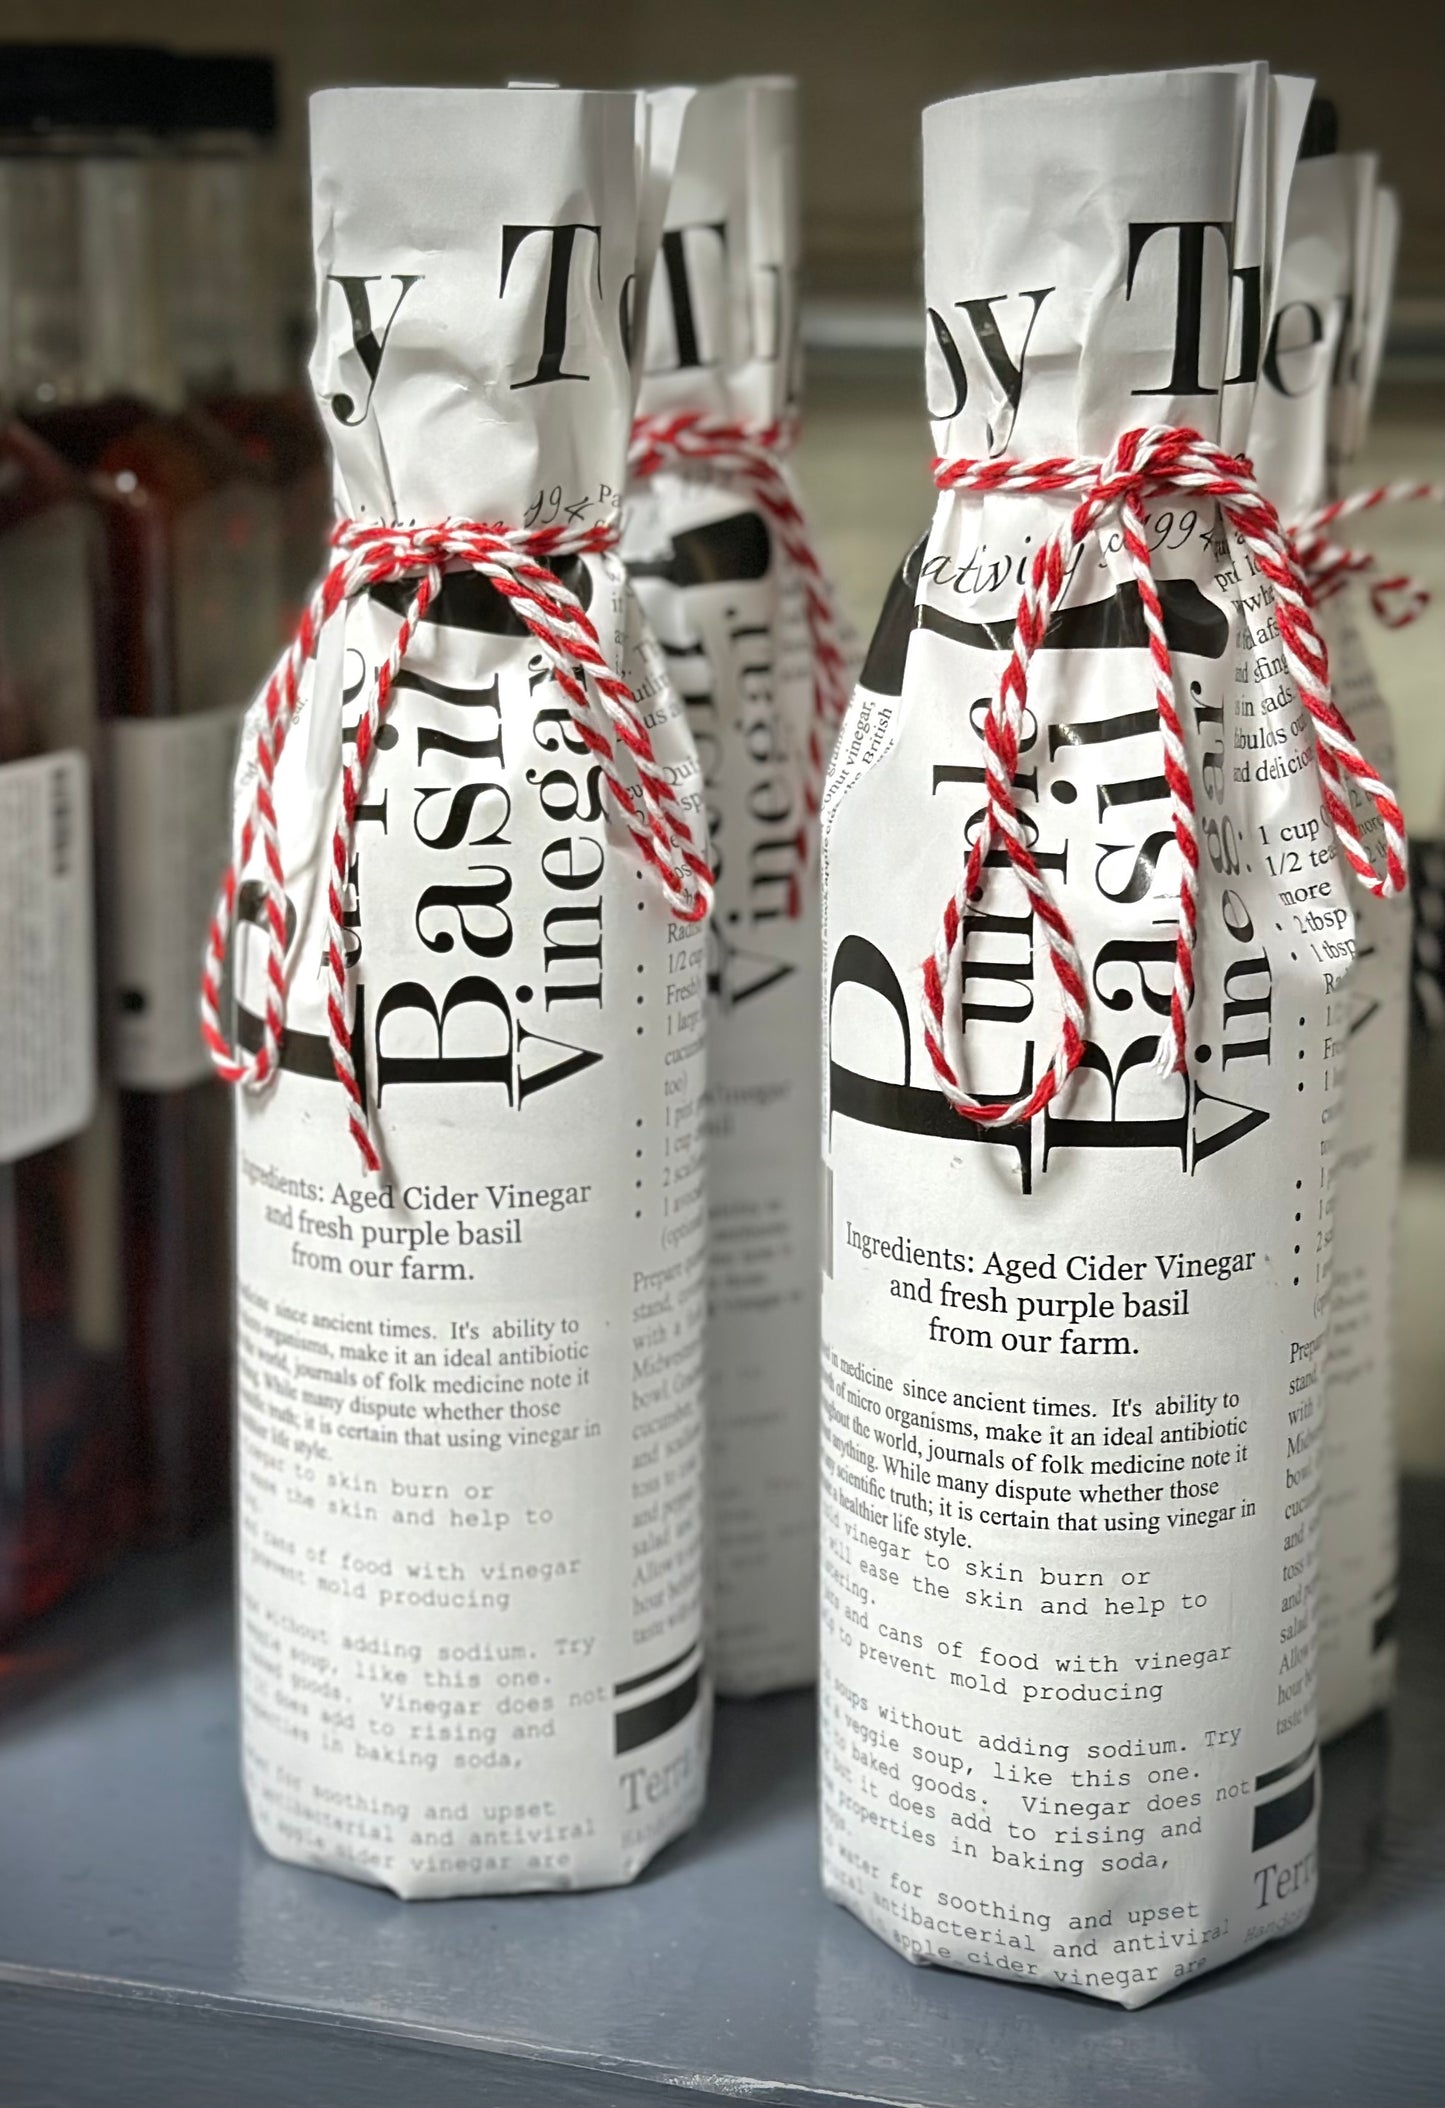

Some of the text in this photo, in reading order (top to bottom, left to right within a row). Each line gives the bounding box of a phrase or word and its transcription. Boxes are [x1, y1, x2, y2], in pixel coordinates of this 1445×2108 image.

[846, 701, 877, 766] vinegar,
[862, 708, 893, 765] British
[1280, 818, 1320, 842] cup
[375, 665, 515, 1108] Basil
[1265, 850, 1302, 877] 1/2
[1278, 881, 1333, 906] more
[1042, 708, 1191, 1173] Basil
[331, 1182, 396, 1213] Aged
[404, 1185, 479, 1210] Cider
[486, 1184, 592, 1212] Vinegar
[299, 1210, 522, 1251] fresh purple basil
[846, 1221, 1256, 1284] Ingredients: Aged Cider Vinegar
[291, 1241, 475, 1280] from our farm.
[312, 1313, 373, 1336] ancient
[379, 1318, 437, 1339] times.
[450, 1321, 480, 1340] It's
[492, 1318, 555, 1340] ability
[561, 1317, 579, 1333] to
[890, 1278, 1189, 1324] and fresh purple basil
[443, 1341, 589, 1367] ideal antibiotic
[929, 1316, 1139, 1355] from our farm.
[433, 1369, 572, 1394] medicine note
[840, 1362, 1239, 1417] medicine since ancient times. It's ability to
[423, 1400, 561, 1421] whether those
[447, 1423, 580, 1451] using vinegar
[847, 1389, 1248, 1447] micro organisms, make it an ideal antibiotic
[852, 1416, 1231, 1474] the world, journals of folk medicine note
[836, 1464, 1257, 1535] scientific truth; is certain that using vinegar in
[883, 1454, 931, 1485] While
[937, 1474, 988, 1499] many
[995, 1479, 1072, 1506] dispute
[1079, 1483, 1163, 1503] whether
[1170, 1481, 1219, 1500] those
[450, 1508, 510, 1531] help
[839, 1487, 972, 1549] healthier life style.
[406, 1558, 582, 1582] with vinegar
[845, 1522, 1151, 1586] vinegar to skin burn or
[379, 1588, 510, 1612] producing
[859, 1558, 1207, 1617] ease the skin and help to
[438, 1643, 536, 1662] sodium.
[859, 1642, 1164, 1703] prevent mold producing
[878, 1622, 1232, 1673] cans food with vinegar
[845, 1712, 1200, 1787] veggie soup, like this one.
[878, 1704, 1242, 1762] without adding sodium. Try
[852, 1743, 1250, 1820] baked goods. Vinegar does not
[839, 1791, 1169, 1877] properties in baking soda,
[889, 1791, 1202, 1846] does add to rising and
[873, 1892, 1036, 1952] antibacterial
[1053, 1939, 1098, 1958] and
[1113, 1919, 1229, 1954] antiviral
[891, 1872, 1201, 1932] for soothing and upset
[967, 1951, 1039, 1976] cider
[1053, 1966, 1159, 1989] vinegar
